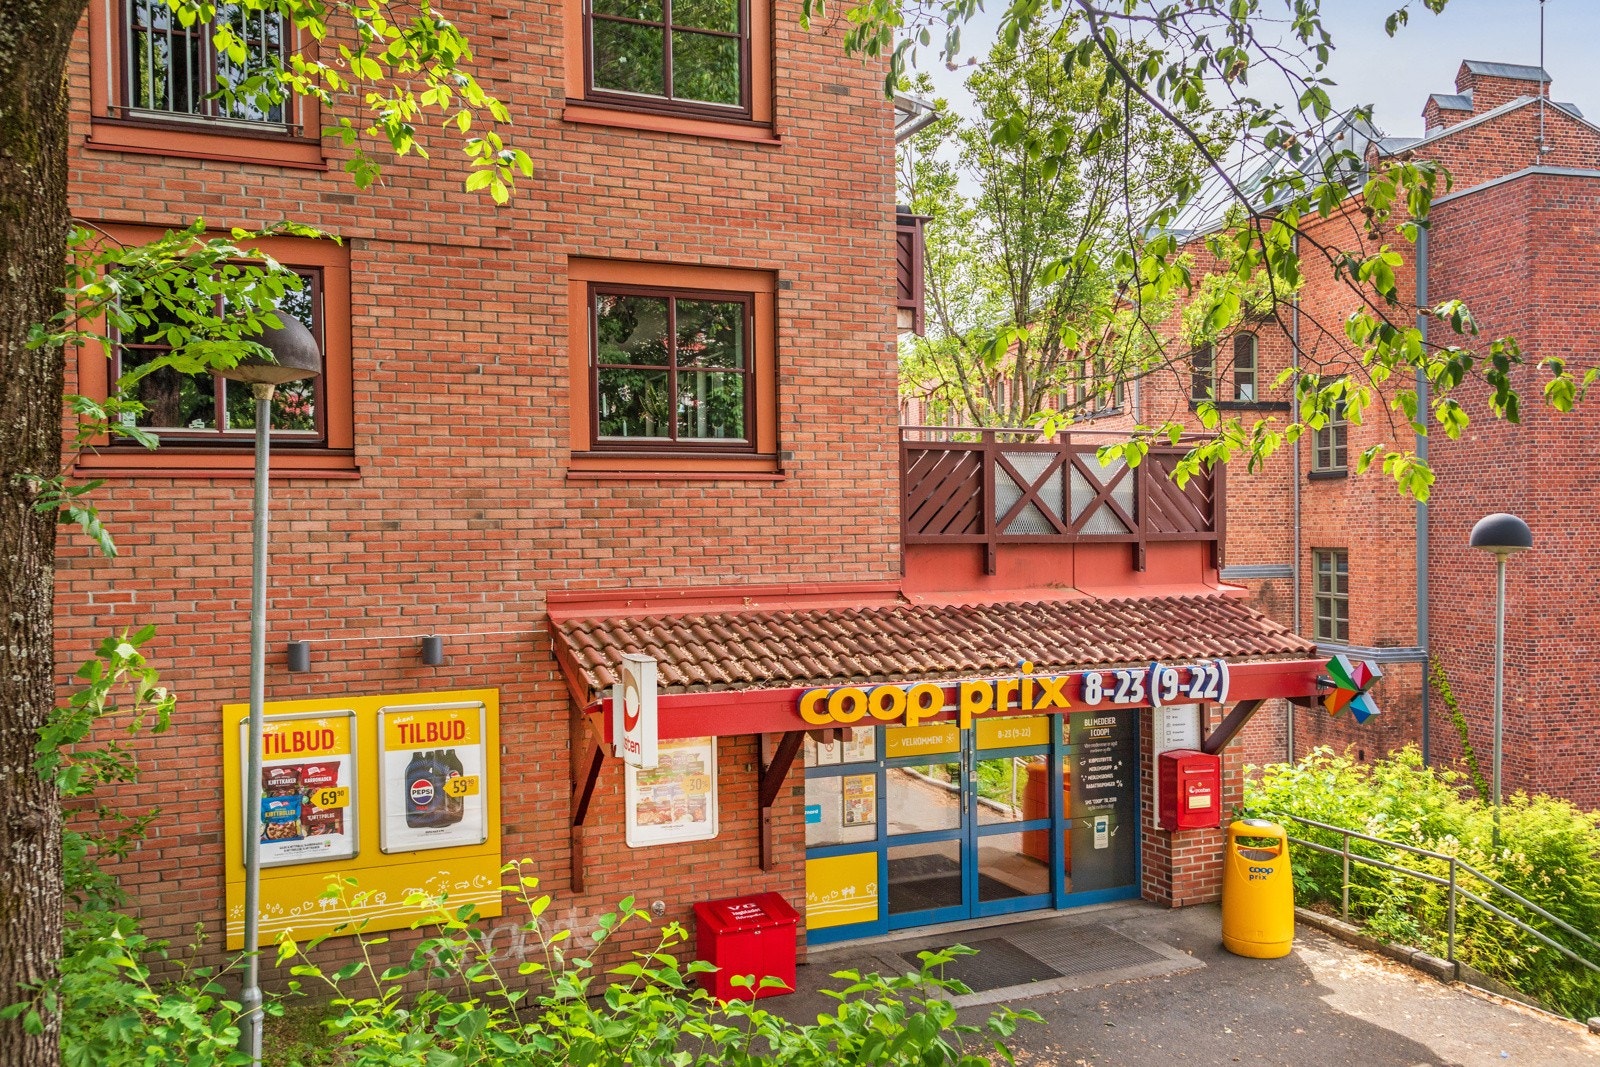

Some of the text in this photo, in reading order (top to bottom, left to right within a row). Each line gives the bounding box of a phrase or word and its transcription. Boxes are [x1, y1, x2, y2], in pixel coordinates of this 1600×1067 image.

[799, 658, 1230, 730] coop prix 8-23 (9-22)
[1084, 718, 1093, 727] BLI
[398, 720, 466, 745] TILBUD
[1093, 728, 1110, 737] COOP!
[262, 728, 335, 755] TILBUD
[901, 735, 943, 747] VELKOMMEN!
[453, 780, 468, 794] 59
[321, 791, 337, 806] 69
[1248, 866, 1274, 875] coop
